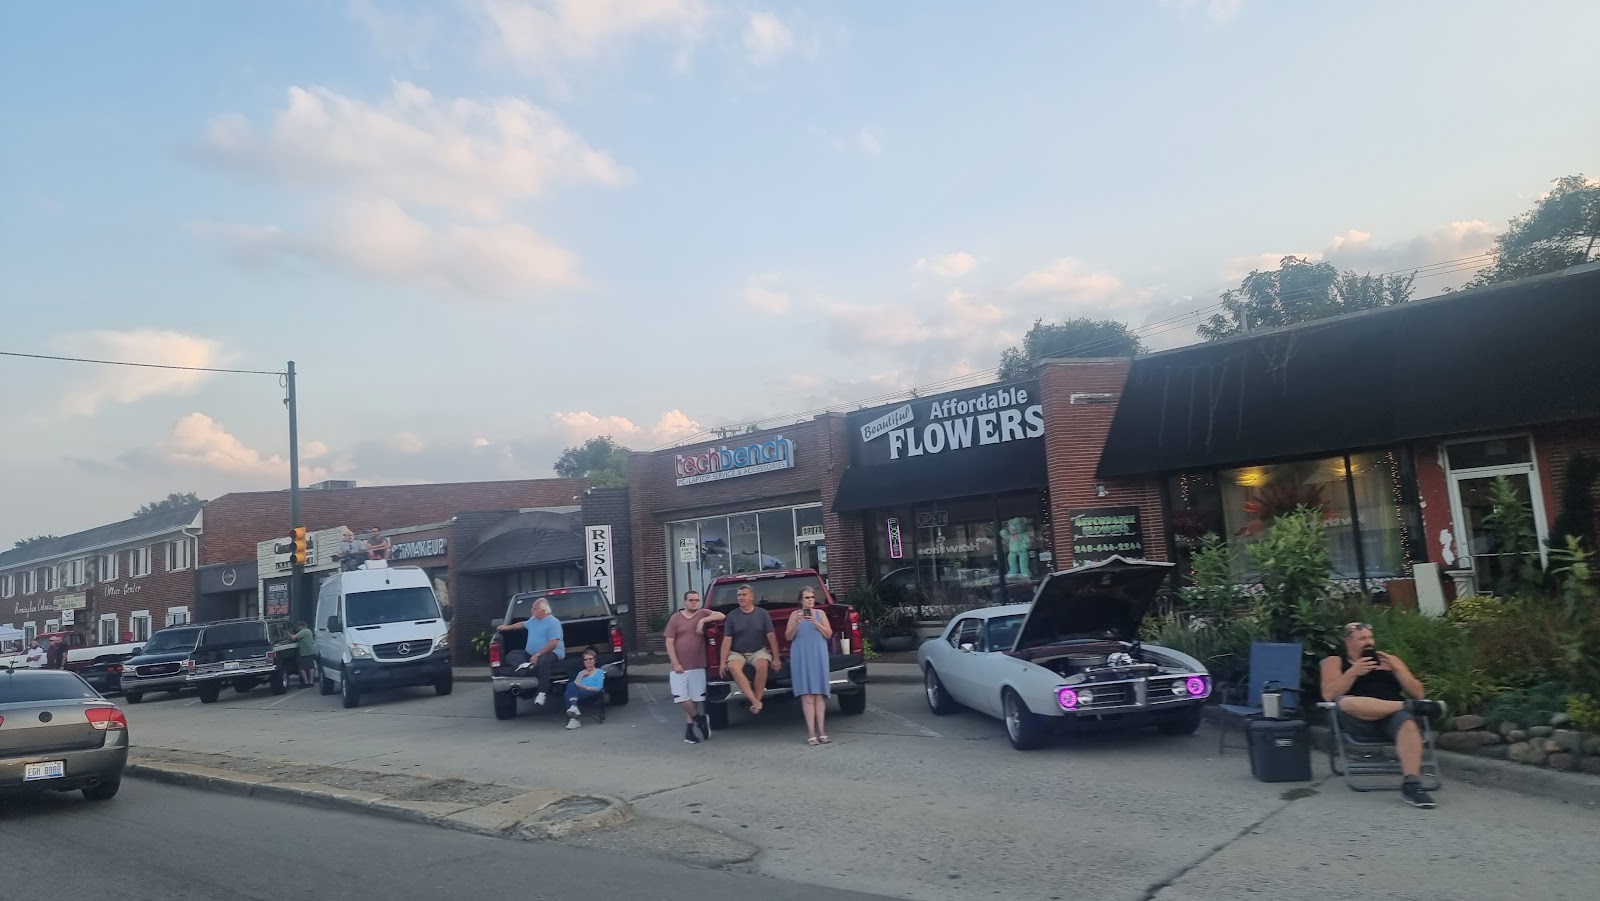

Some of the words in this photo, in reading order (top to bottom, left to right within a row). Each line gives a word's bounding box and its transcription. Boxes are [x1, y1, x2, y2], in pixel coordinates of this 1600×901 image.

[930, 387, 1028, 420] Affordable
[863, 407, 910, 439] Beautiful
[888, 404, 1045, 460] FLOWERS
[675, 435, 793, 478] techbench
[712, 470, 736, 479] SERVICE
[743, 462, 786, 474] ACCESSORIES
[591, 529, 608, 594] RESAL
